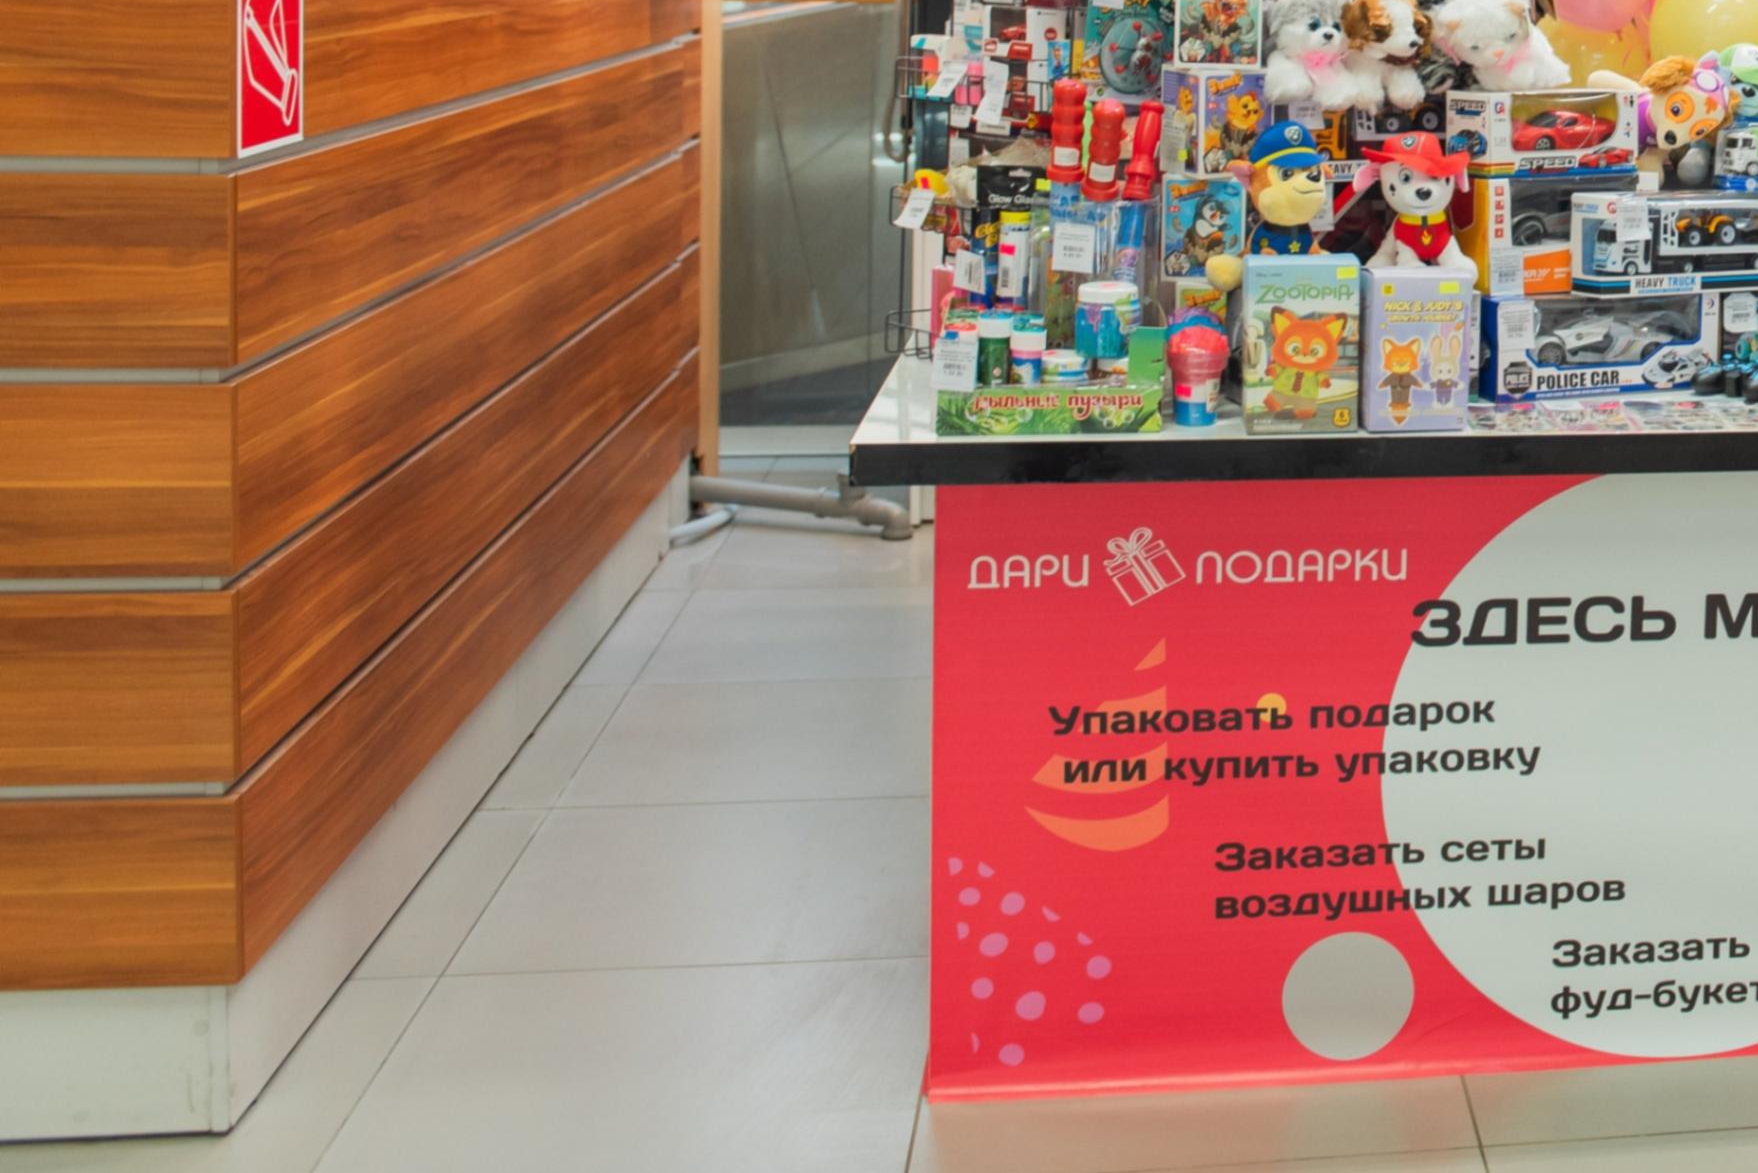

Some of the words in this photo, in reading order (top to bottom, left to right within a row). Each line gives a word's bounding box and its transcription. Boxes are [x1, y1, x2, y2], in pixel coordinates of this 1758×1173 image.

[1518, 156, 1578, 169] SPEED
[988, 192, 1012, 204] Glow
[1635, 277, 1665, 290] HEAVY
[1667, 275, 1697, 288] TRUCK
[1384, 301, 1412, 312] NICK
[1536, 371, 1585, 390] POLICE
[1589, 369, 1620, 386] CAR
[1068, 393, 1143, 420] пузыри
[968, 555, 1088, 588] ДАРИ
[1197, 549, 1407, 583] ПОДАРКИ
[1412, 596, 1676, 647] ЗДЕСЬ
[1049, 707, 1292, 735] Упаковать
[1311, 701, 1494, 731] подарок
[1064, 760, 1145, 783] или
[1165, 756, 1318, 786] купить
[1336, 747, 1540, 782] упаковку
[1216, 843, 1424, 871] Заказать
[1441, 839, 1545, 862] сеты
[1216, 886, 1471, 920] воздушных
[1488, 880, 1625, 910] шаров
[1553, 937, 1750, 968] Заказать
